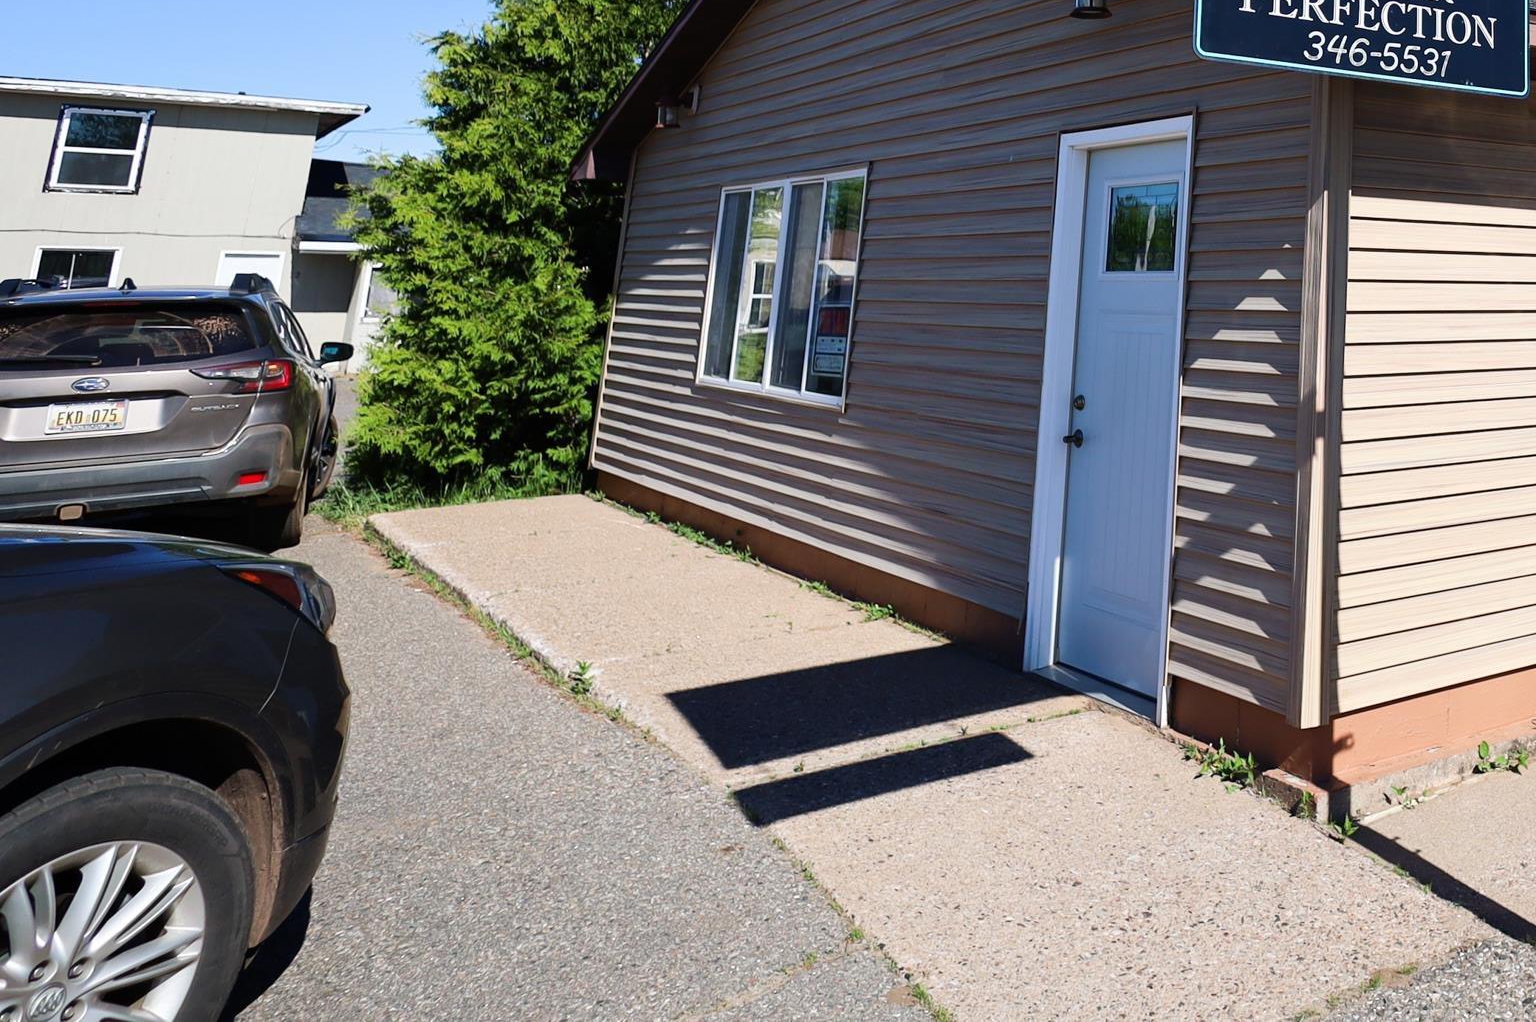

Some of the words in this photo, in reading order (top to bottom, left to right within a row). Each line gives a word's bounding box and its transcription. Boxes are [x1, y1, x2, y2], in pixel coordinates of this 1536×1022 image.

[1303, 30, 1452, 78] 346-5531
[56, 410, 84, 426] EKD
[91, 408, 118, 424] 075
